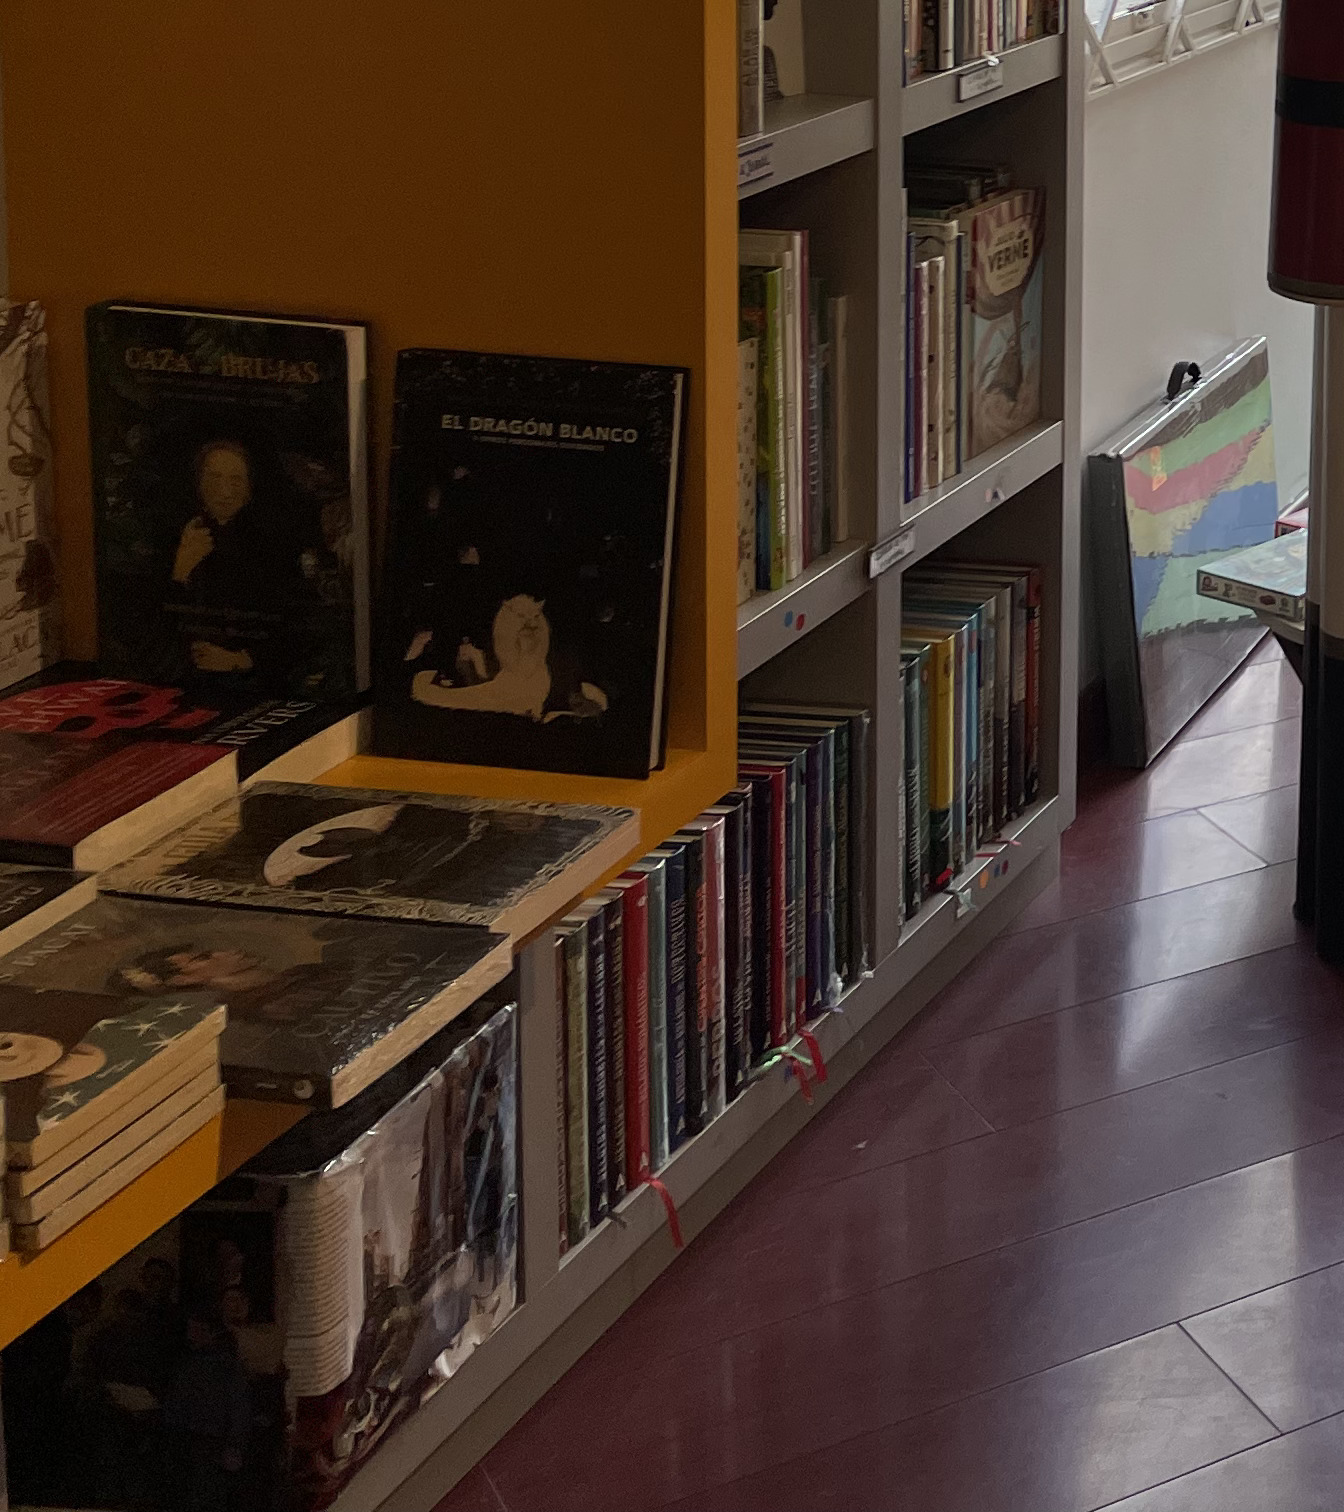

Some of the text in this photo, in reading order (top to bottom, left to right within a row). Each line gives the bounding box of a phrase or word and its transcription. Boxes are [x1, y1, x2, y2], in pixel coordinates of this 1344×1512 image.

[987, 238, 1030, 274] VERNE
[441, 414, 464, 430] EL
[469, 416, 553, 437] DRAGÓN
[559, 423, 639, 444] BLANCO
